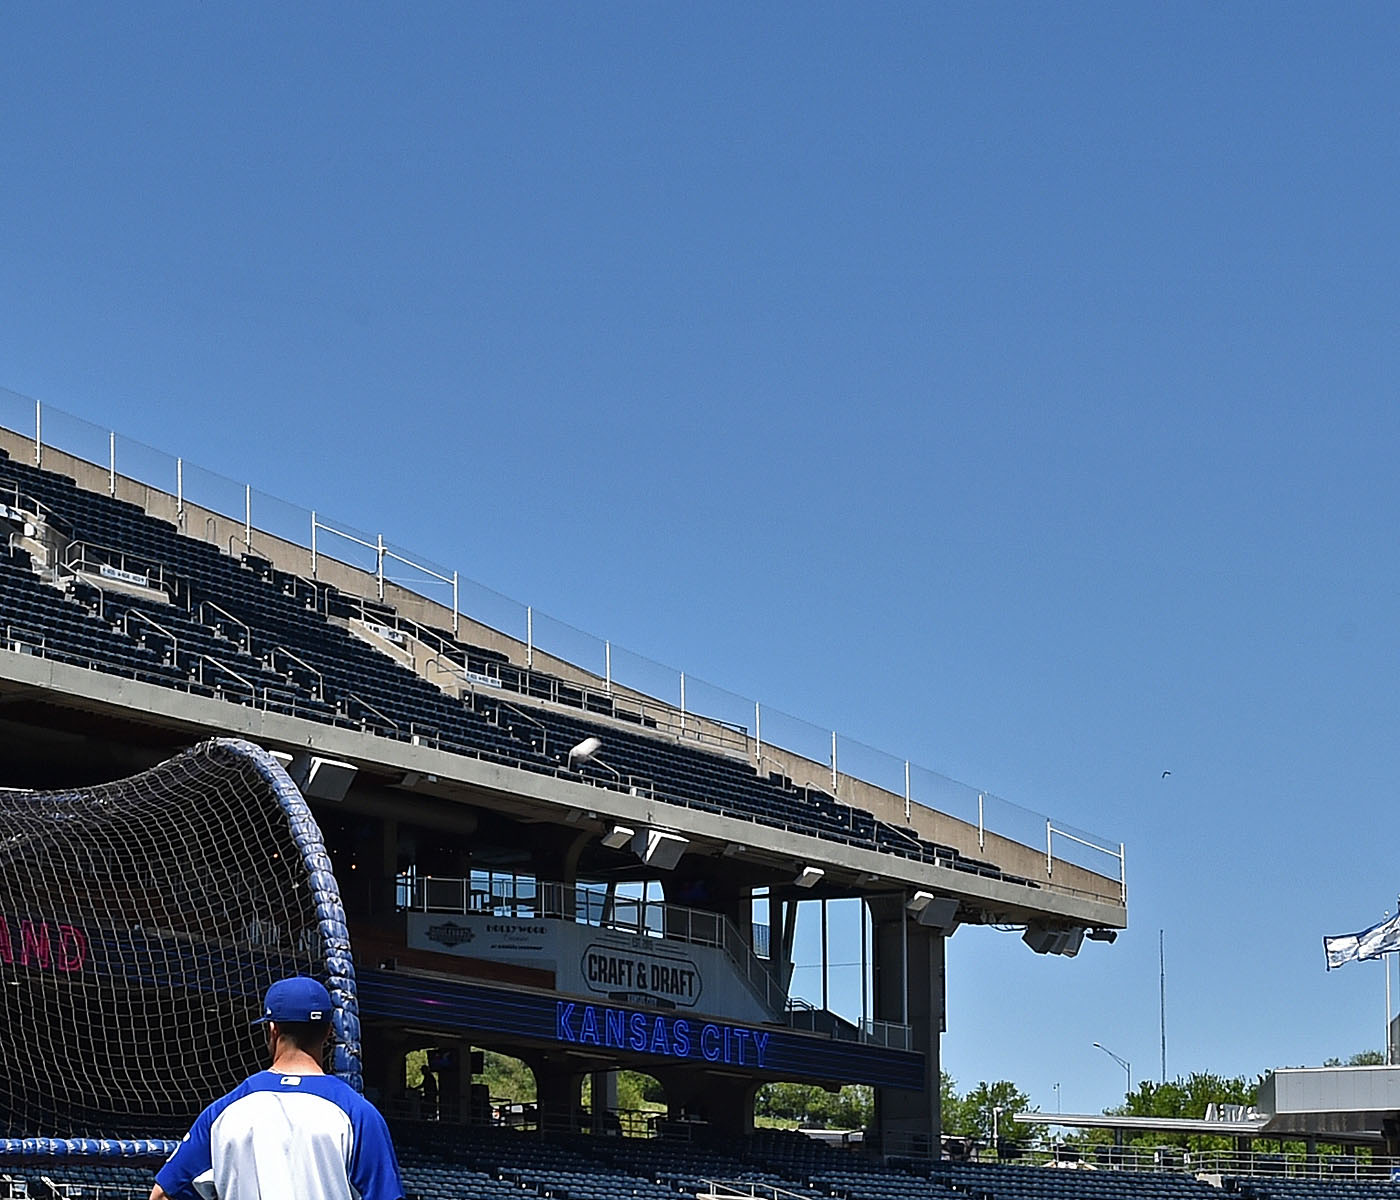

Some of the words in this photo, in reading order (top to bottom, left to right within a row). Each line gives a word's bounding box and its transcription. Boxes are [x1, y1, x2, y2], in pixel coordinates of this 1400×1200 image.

[588, 954, 634, 987] CRAFT
[636, 961, 649, 990] &
[651, 966, 695, 998] DRAFT
[557, 1001, 691, 1057] KANSAS
[701, 1024, 769, 1068] CITY
